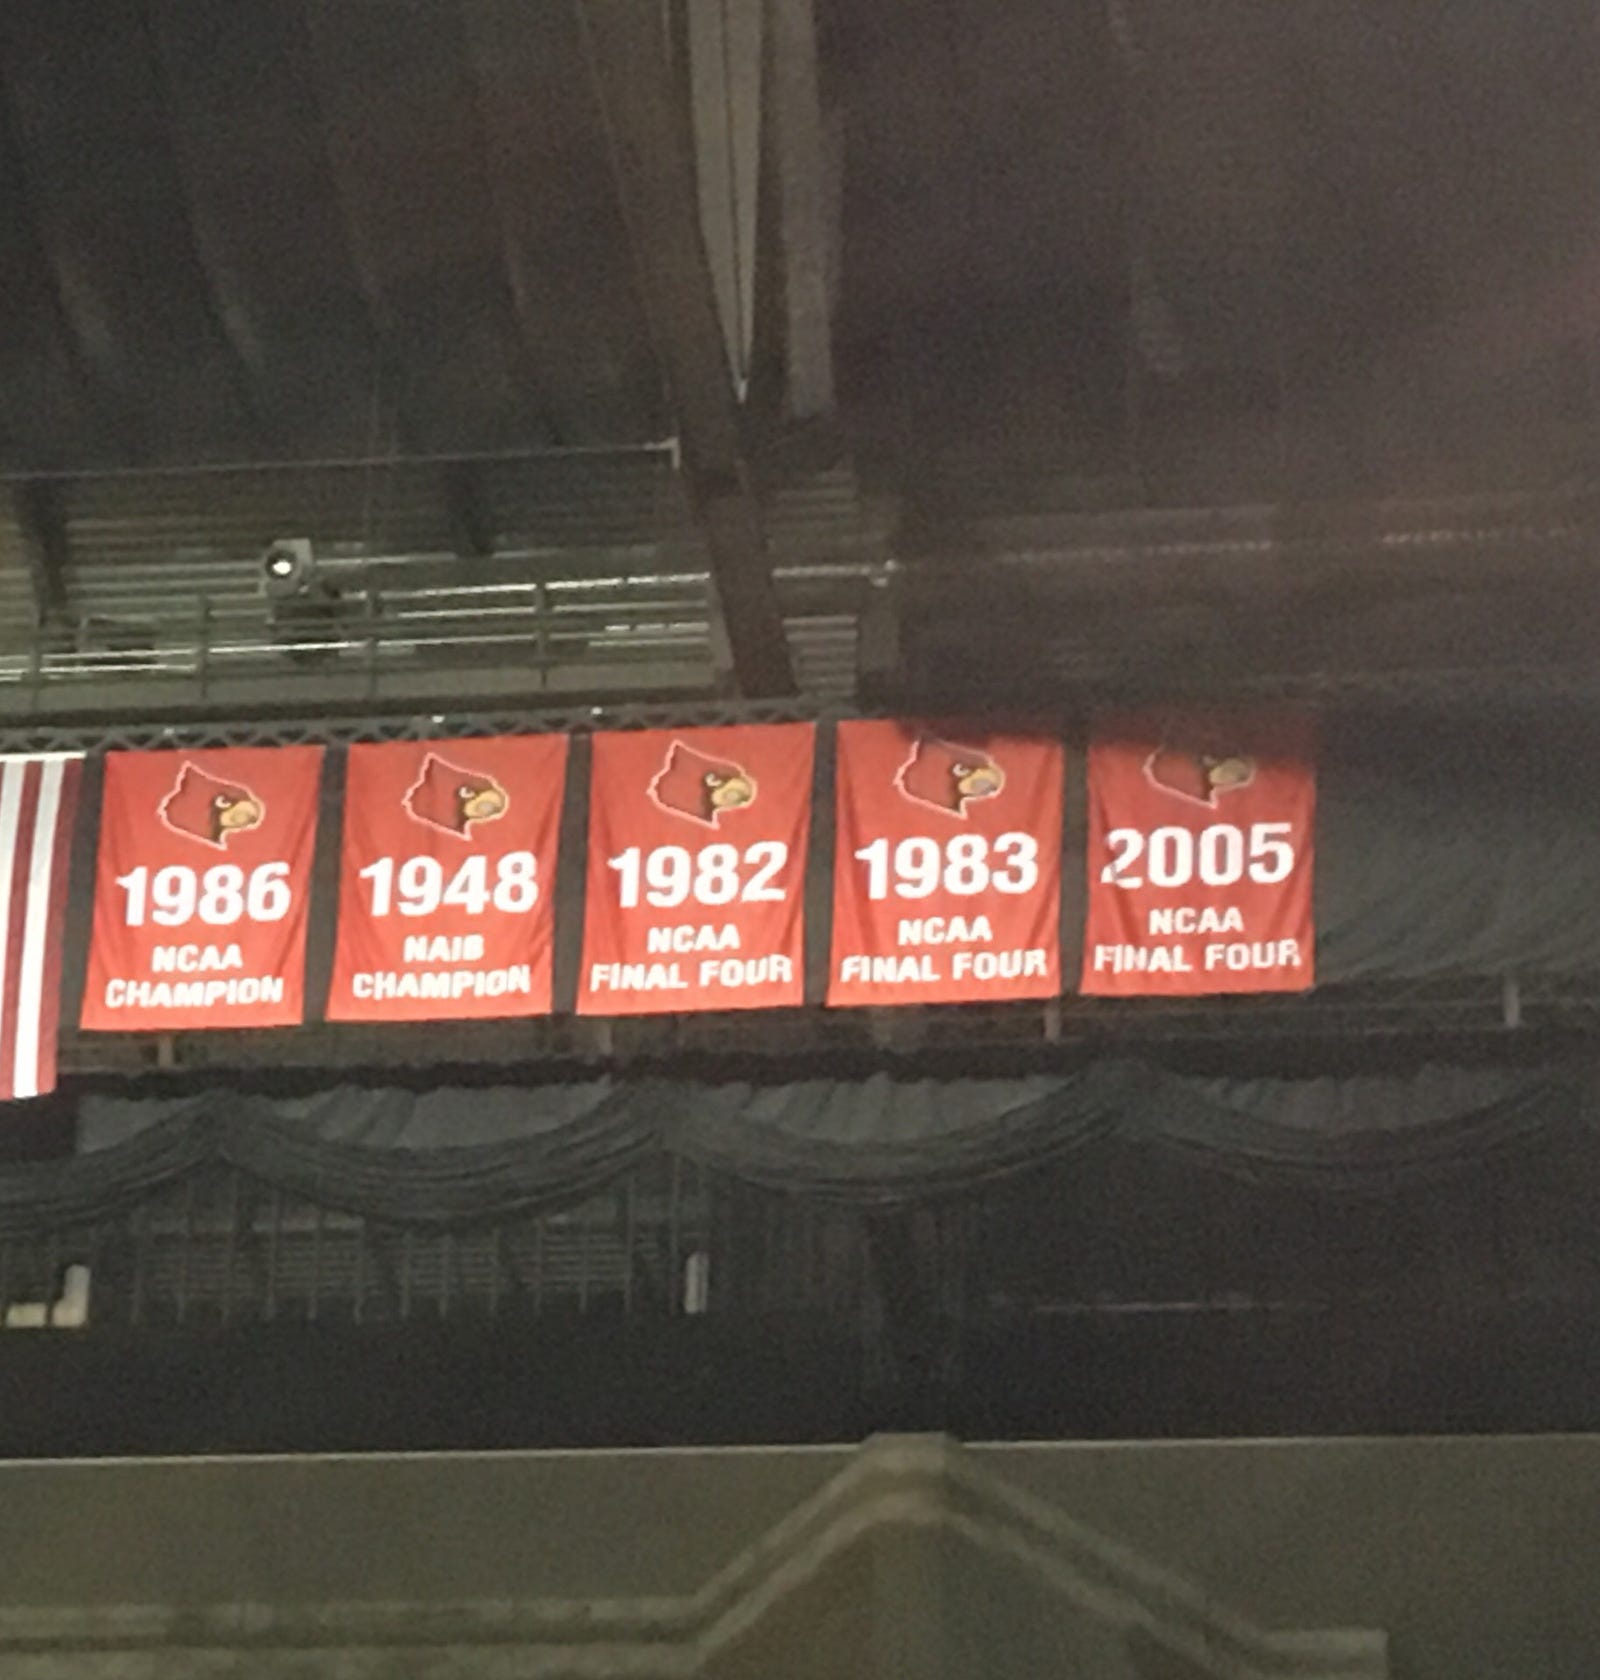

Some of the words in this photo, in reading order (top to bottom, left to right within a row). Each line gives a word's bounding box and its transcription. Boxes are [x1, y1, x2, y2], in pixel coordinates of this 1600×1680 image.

[854, 831, 1039, 900] 1983
[1100, 822, 1295, 889] 2005
[359, 851, 539, 917] 1948
[608, 840, 788, 909] 1982
[116, 861, 292, 927] 1986
[647, 923, 741, 954] NCAA
[898, 915, 993, 946] NCAA
[1149, 906, 1244, 936] NCAA
[151, 943, 244, 973] NCAA
[590, 962, 689, 992] FINAL
[698, 953, 793, 988] FOUR
[840, 954, 941, 983] FINAL
[952, 948, 1048, 981] FOUR
[1093, 943, 1193, 974] FINAL
[1204, 938, 1302, 971] FOUR
[105, 975, 284, 1008] CHAMPION
[352, 964, 531, 1001] CHAMPION
